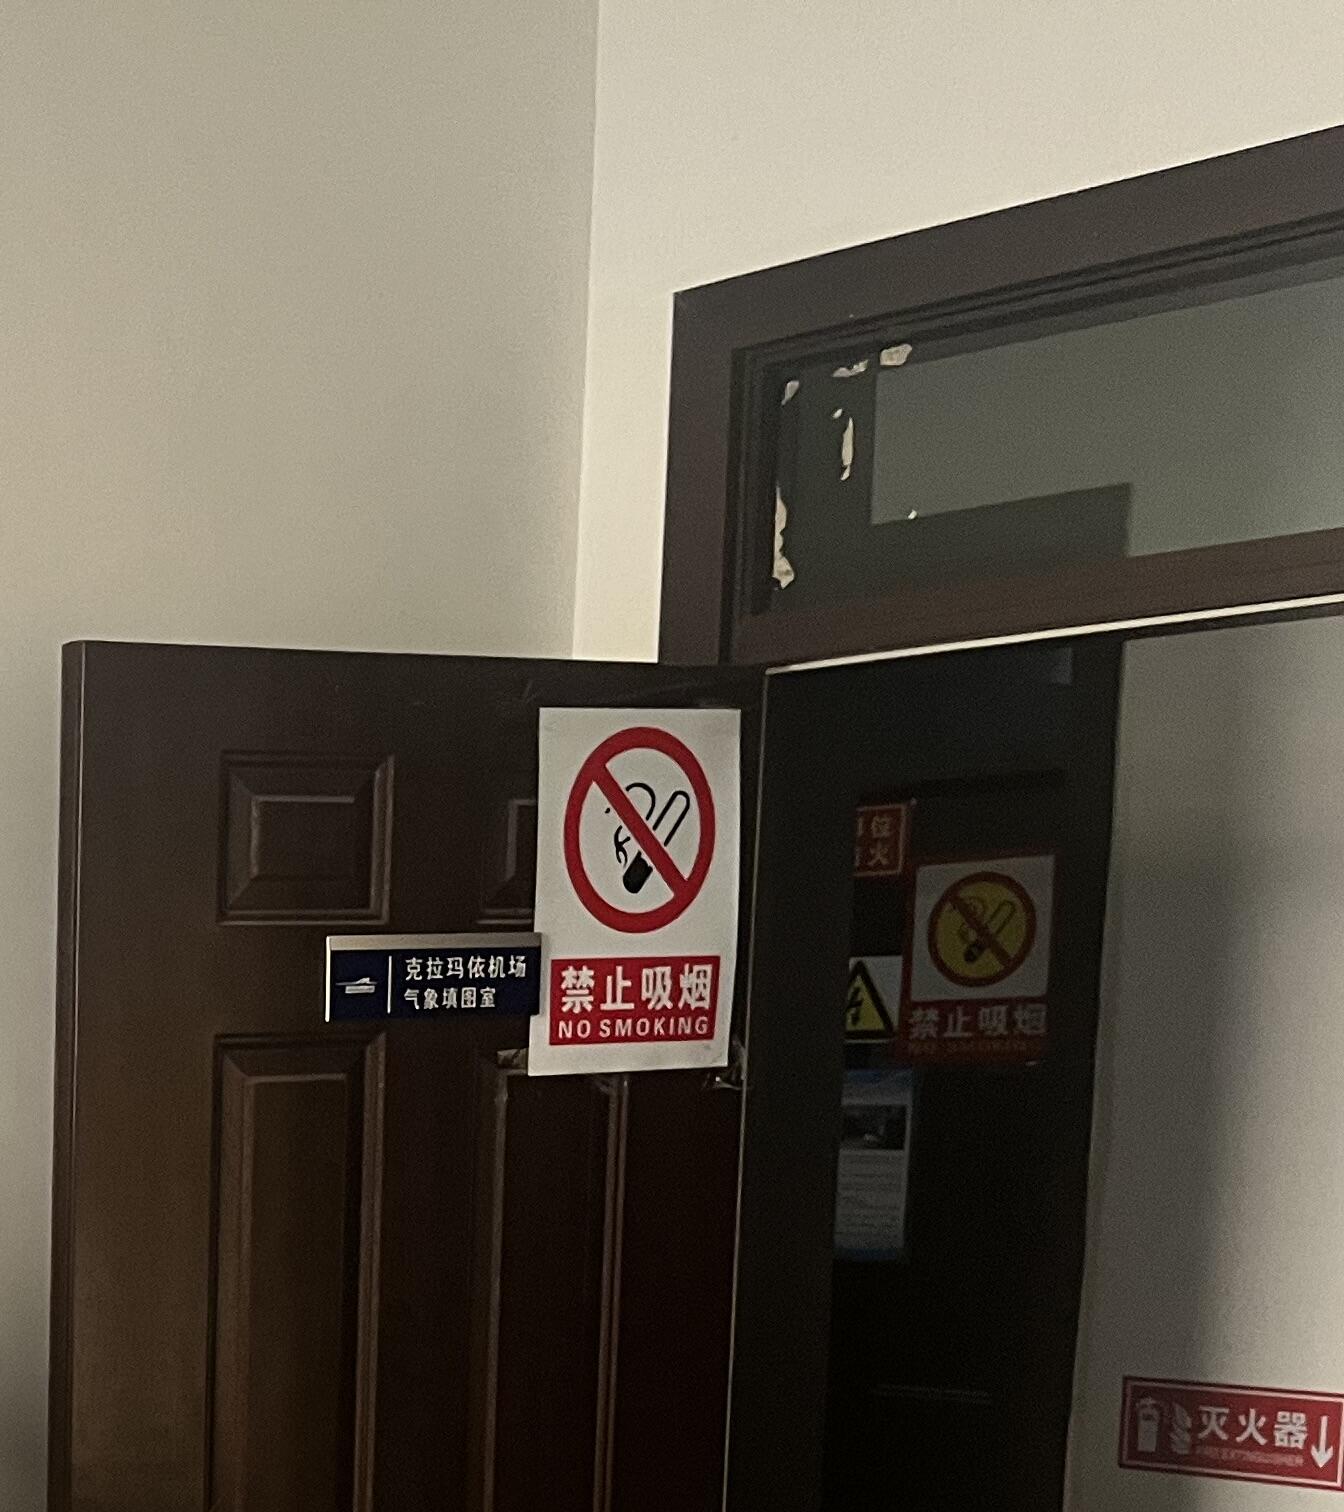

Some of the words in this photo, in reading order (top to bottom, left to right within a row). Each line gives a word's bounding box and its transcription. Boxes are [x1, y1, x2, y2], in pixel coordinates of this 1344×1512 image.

[404, 955, 527, 981] 克拉玛依机场
[403, 987, 496, 1010] 气象填图室
[561, 963, 712, 1014] 禁止吸烟
[558, 1020, 591, 1039] NO
[599, 1016, 710, 1038] SMOKING
[908, 1002, 1048, 1040] 禁止吸烟
[1196, 1404, 1309, 1450] 灭火器
